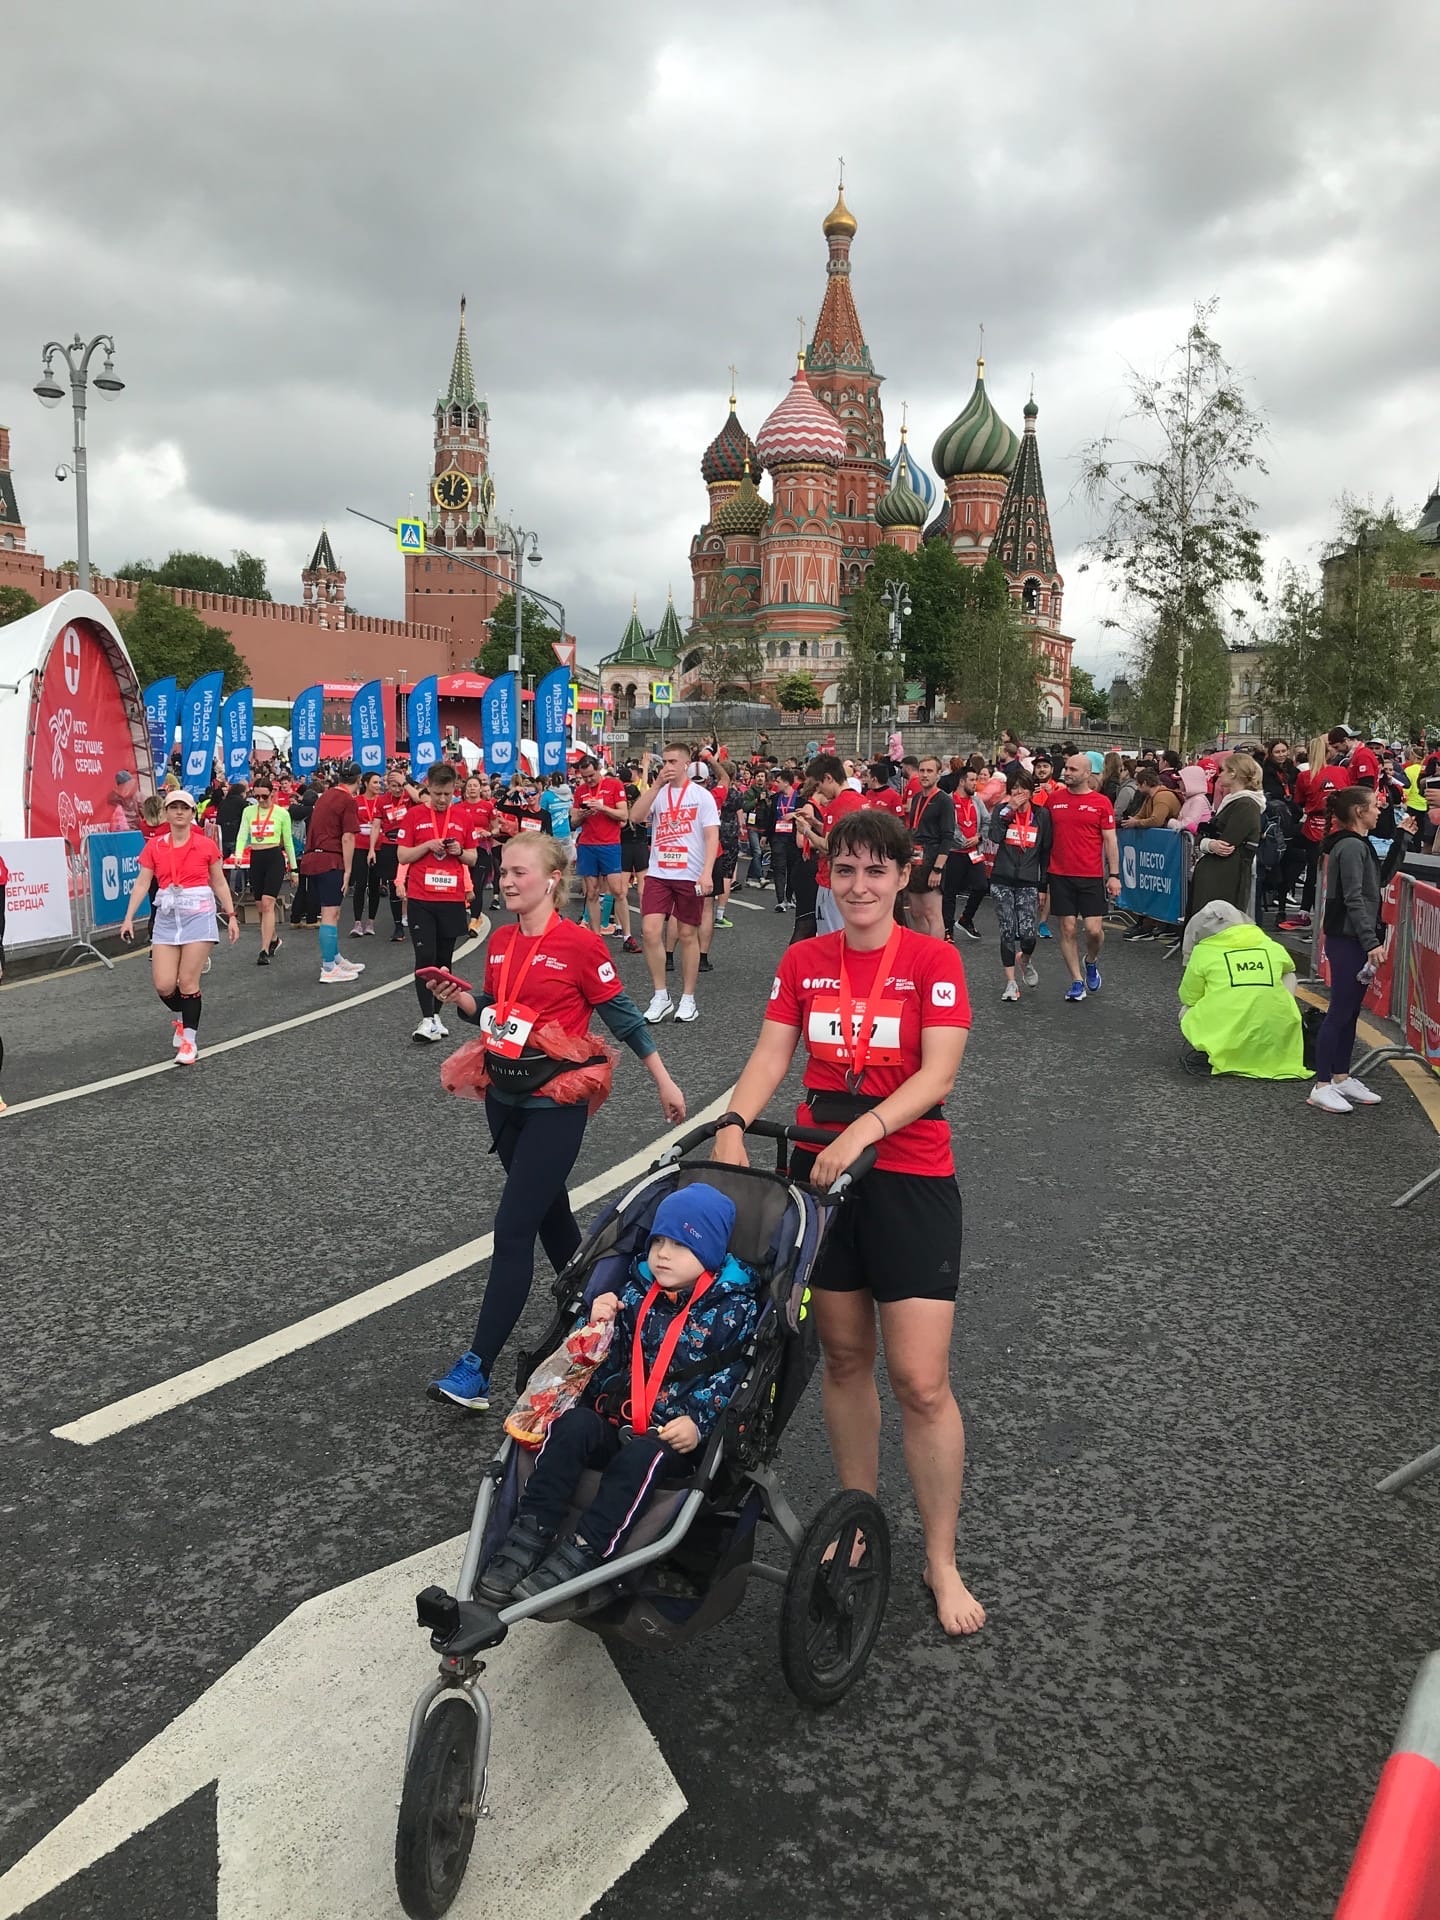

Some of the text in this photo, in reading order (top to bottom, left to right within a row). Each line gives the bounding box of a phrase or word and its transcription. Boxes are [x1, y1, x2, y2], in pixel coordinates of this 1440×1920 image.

[308, 699, 316, 740] ВСТРЕЧИ
[368, 696, 379, 738] ВСТРЕЧИ
[424, 692, 432, 735] ВСТРЕЧИ
[491, 700, 500, 735] МЕСТО
[500, 689, 509, 734] ВСТРЕЧИ
[553, 684, 563, 733] ВСТРЕЧИ
[192, 702, 201, 743] МЕСТО
[230, 710, 238, 742] МЕСТО
[238, 702, 247, 742] ВСТРЕЧИ
[360, 705, 369, 739] МЕСТО
[416, 703, 424, 737] МЕСТО
[74, 739, 104, 756] БЕГУЩИЕ
[301, 752, 314, 762] VK
[365, 751, 379, 761] VK
[419, 748, 432, 758] VK
[495, 748, 508, 758] VK
[75, 758, 102, 775] СЕРДЦА
[1140, 851, 1165, 870] МЕСТО
[6, 883, 49, 897] БЕГУЩИЕ
[1140, 873, 1172, 895] ВСТРЕЧИ
[7, 898, 45, 912] СЕРДЦА
[1236, 961, 1264, 972] M24
[936, 989, 952, 1000] VK
